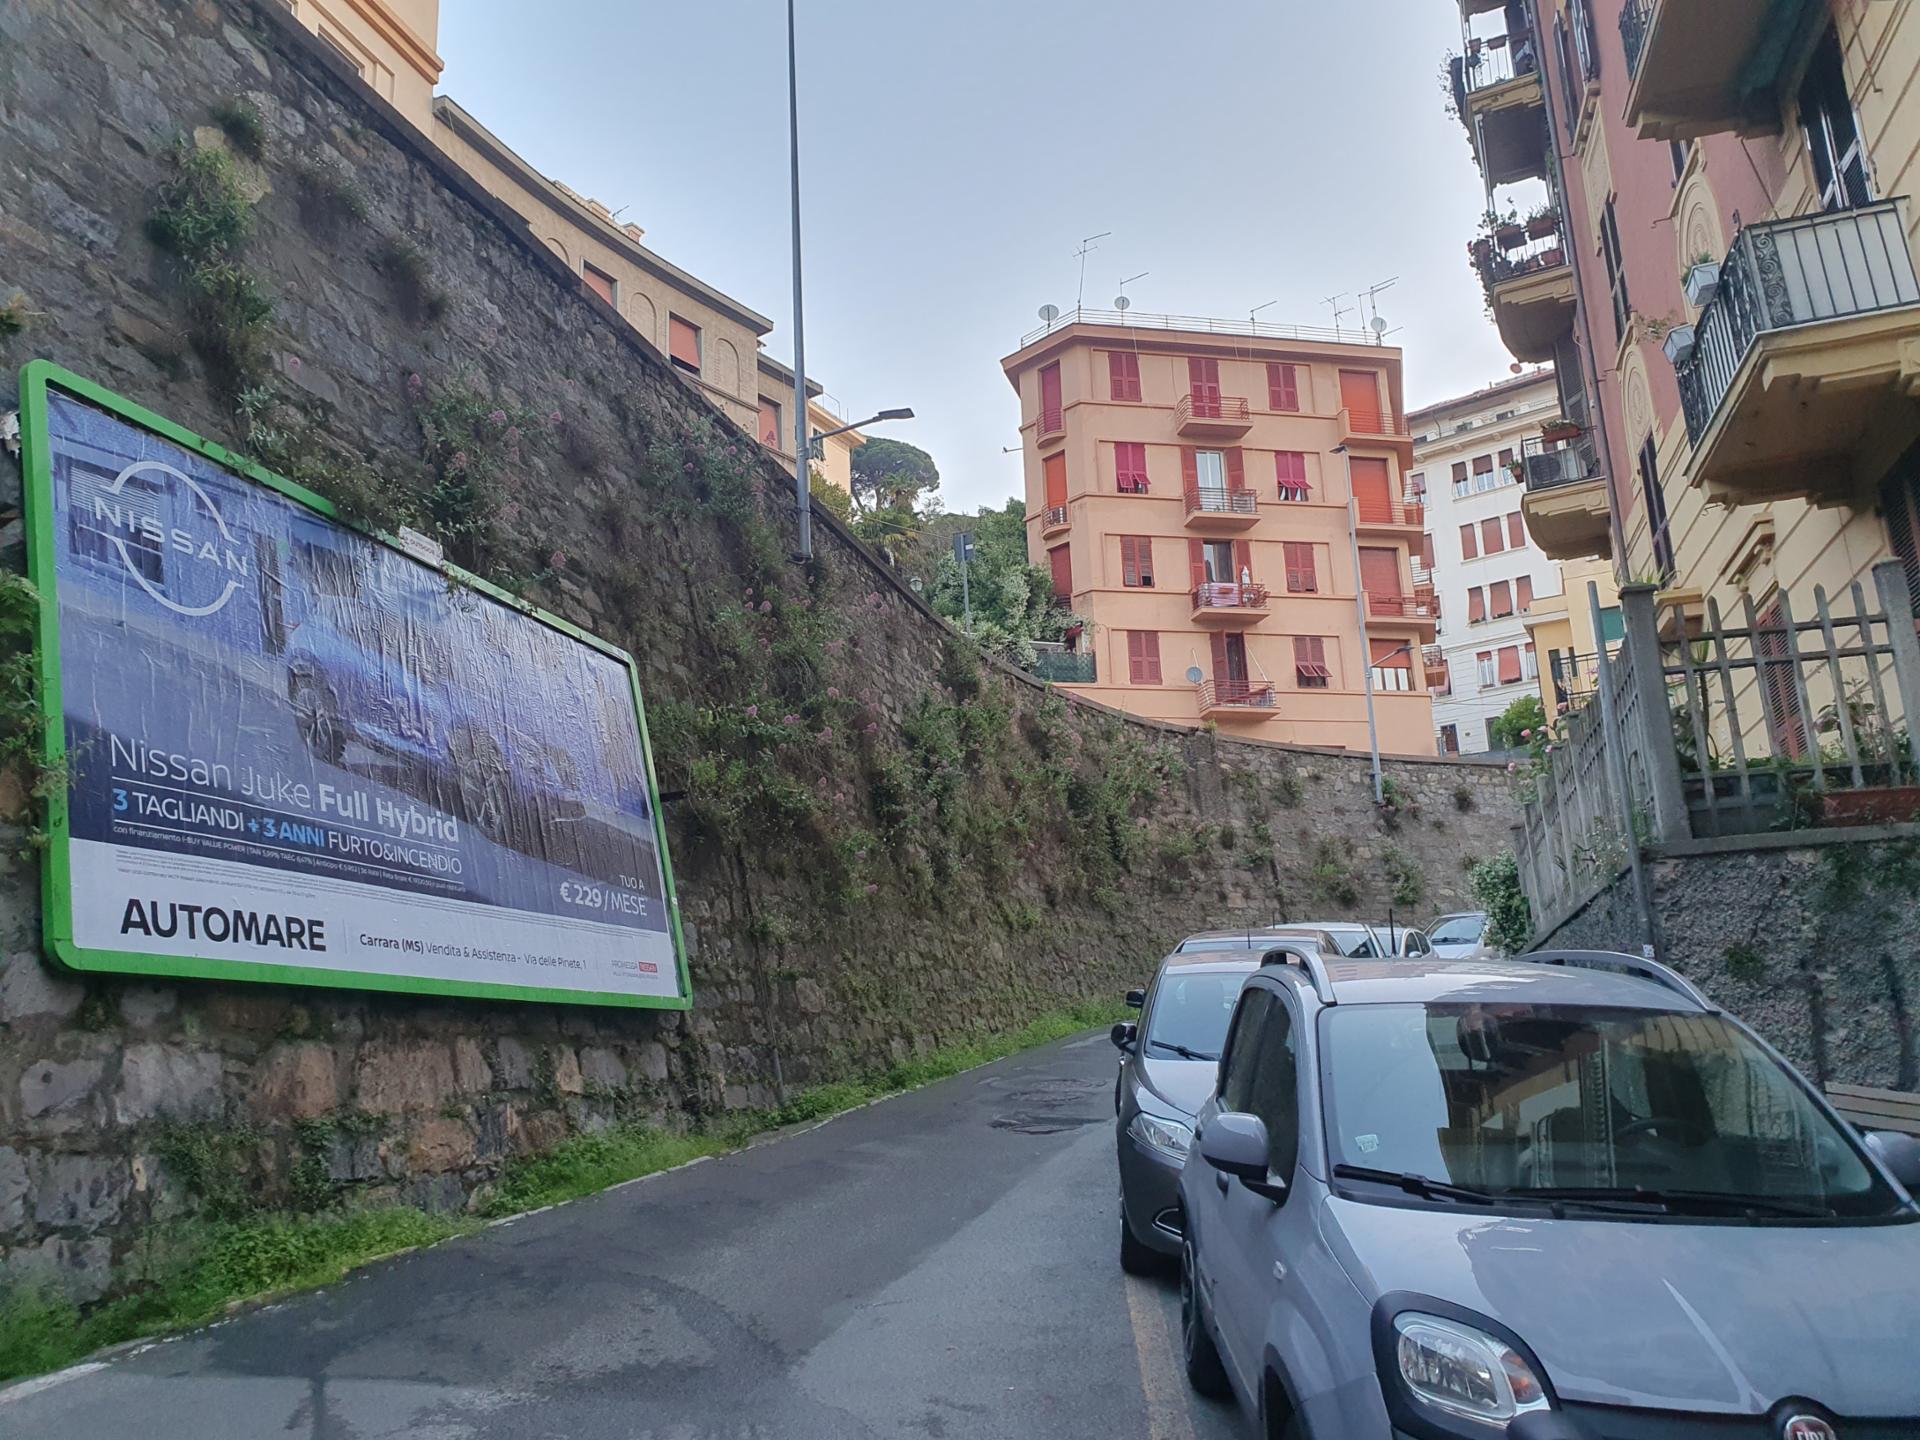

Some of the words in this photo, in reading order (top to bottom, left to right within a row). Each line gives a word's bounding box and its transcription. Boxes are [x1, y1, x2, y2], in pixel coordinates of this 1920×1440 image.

[95, 497, 248, 577] NISSAN
[110, 733, 232, 791] Nissan
[241, 766, 310, 809] Juke
[319, 783, 369, 822] Full
[375, 797, 459, 843] Hybrid
[112, 788, 128, 811] 3
[132, 791, 244, 832] TAGLIANDI
[263, 817, 277, 837] 3
[280, 821, 325, 848] ANNI
[328, 831, 462, 875] FURTO&INCENDIO
[619, 874, 637, 889] TUO
[639, 879, 645, 891] A
[120, 898, 327, 952] AUTOMARE
[360, 933, 400, 950] Carrara
[402, 938, 424, 955] (MS)
[425, 942, 462, 957] Vendita
[463, 946, 470, 958] &
[472, 947, 517, 963] Assistenza
[523, 952, 537, 965] Via
[539, 955, 557, 967] delle
